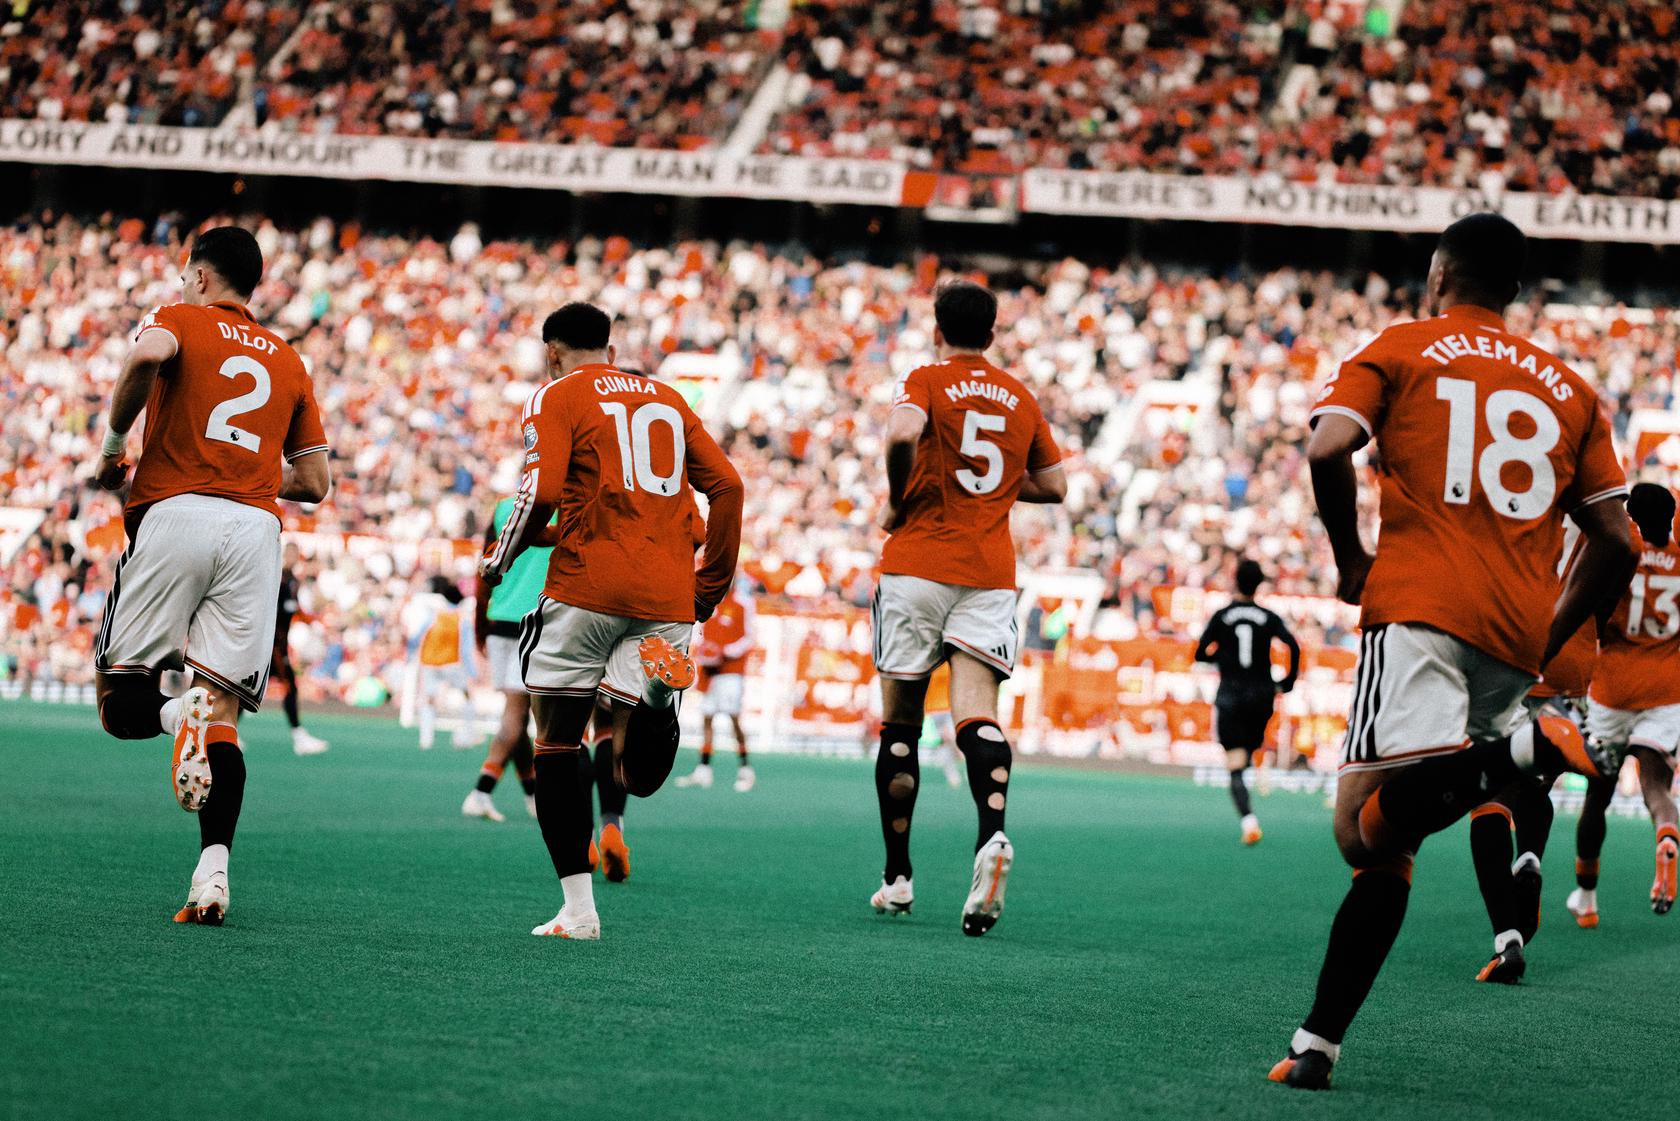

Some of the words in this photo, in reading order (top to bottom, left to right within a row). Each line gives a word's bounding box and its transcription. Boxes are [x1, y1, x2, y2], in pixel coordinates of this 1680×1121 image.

[108, 130, 183, 156] AND
[402, 146, 461, 170] THE
[489, 149, 607, 176] GREAT
[634, 157, 714, 183] MAN
[737, 161, 779, 186] HE
[805, 163, 891, 191] SAID
[1246, 187, 1418, 219] NOTHING
[1536, 199, 1671, 230] EARTH
[217, 321, 278, 355] DALOT
[1421, 334, 1574, 402] TIELEMANS
[205, 355, 271, 454] 2
[594, 376, 657, 395] CUNHA
[945, 380, 1019, 411] MAGUIRE
[599, 402, 685, 497] 10
[955, 410, 1006, 494] 5
[1436, 376, 1561, 520] 18
[1626, 572, 1680, 640] 13
[1234, 623, 1253, 669] 1
